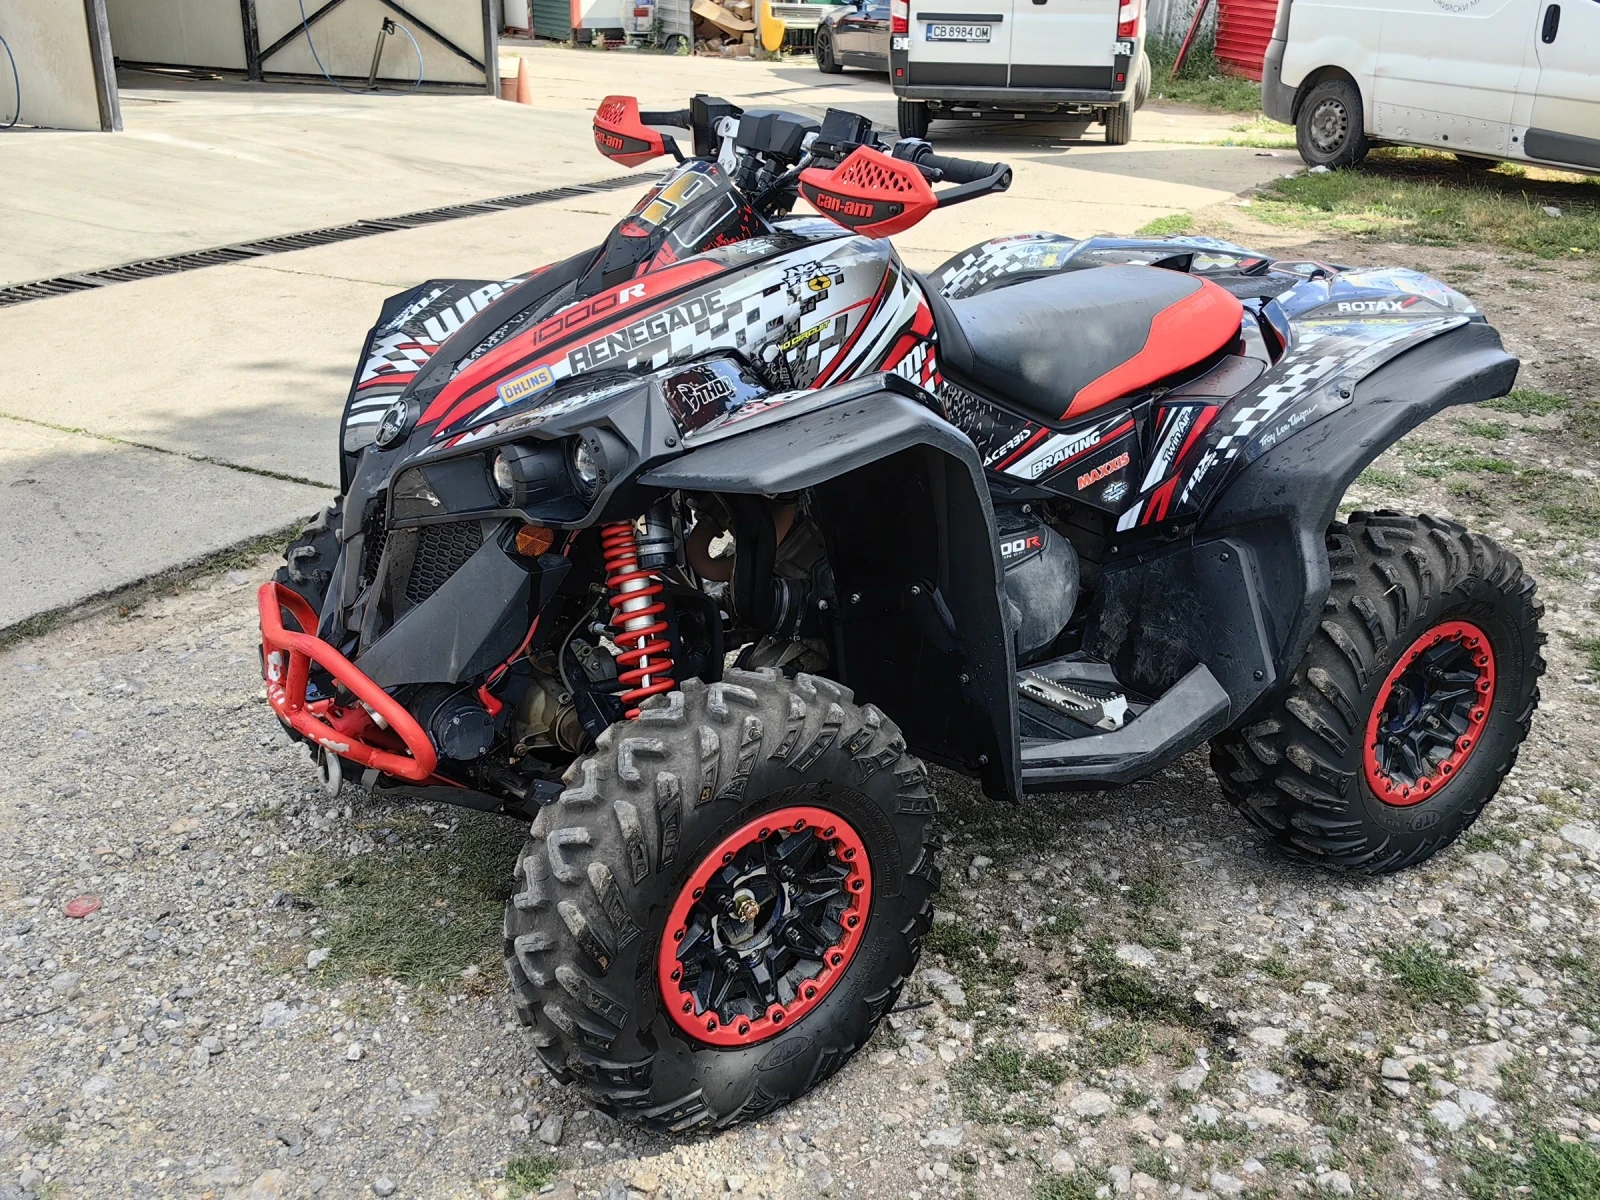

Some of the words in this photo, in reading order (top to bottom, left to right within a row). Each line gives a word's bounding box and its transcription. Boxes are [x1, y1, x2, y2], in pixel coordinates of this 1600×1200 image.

[933, 26, 947, 37] CB
[949, 27, 973, 38] 8984
[975, 28, 988, 38] OM
[595, 129, 623, 150] can-am
[816, 193, 874, 218] can-am
[782, 264, 843, 288] FEAR
[783, 260, 818, 278] NO
[532, 282, 647, 347] 1000R
[1337, 301, 1404, 313] ROTAX
[566, 287, 728, 376] RENEGADE
[791, 320, 831, 346] CIRCUIT
[504, 370, 549, 399] ÖHLINS
[694, 376, 737, 405] THOR
[382, 421, 398, 433] BRP
[1259, 432, 1276, 446] Troy
[1276, 426, 1290, 436] Lee
[1031, 430, 1100, 477] BRAKING
[1077, 452, 1131, 490] MAXXIS
